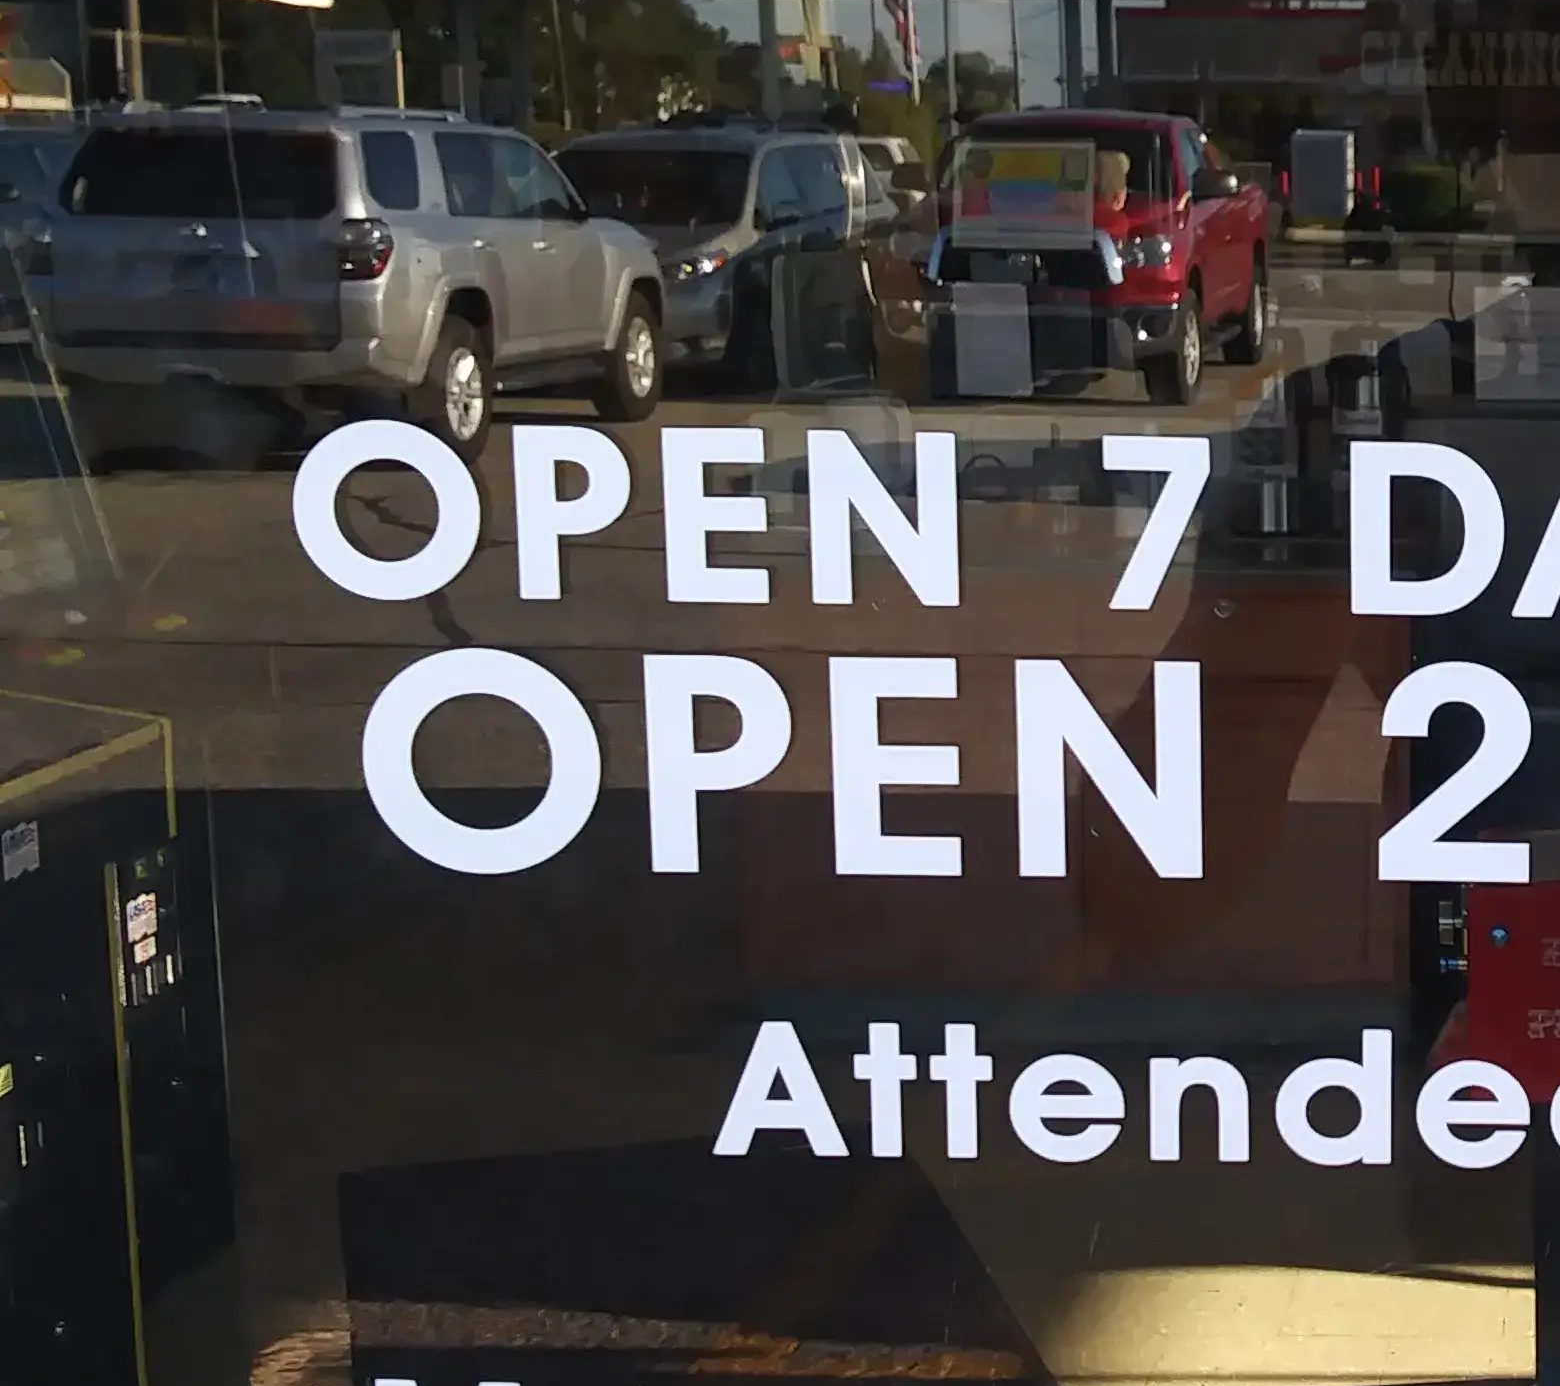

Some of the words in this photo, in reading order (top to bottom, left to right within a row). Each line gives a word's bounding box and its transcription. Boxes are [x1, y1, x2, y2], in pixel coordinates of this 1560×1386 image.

[292, 418, 961, 607] OPEN
[1101, 434, 1211, 611] 7
[361, 646, 1204, 879] OPEN
